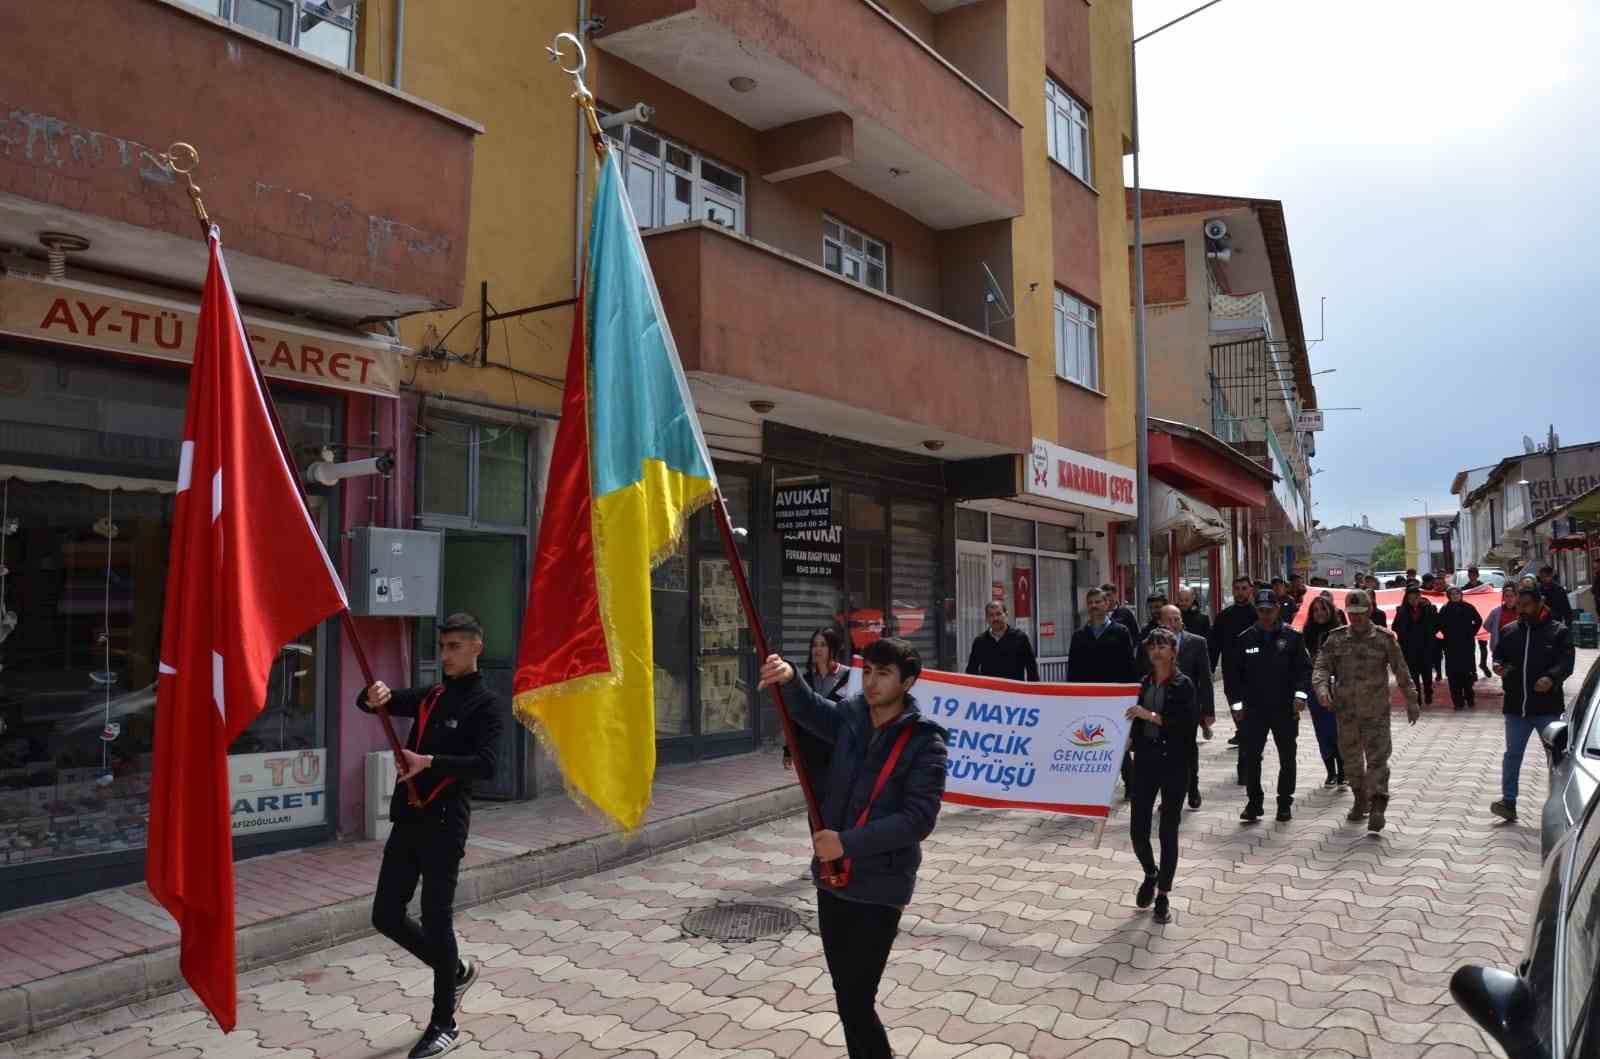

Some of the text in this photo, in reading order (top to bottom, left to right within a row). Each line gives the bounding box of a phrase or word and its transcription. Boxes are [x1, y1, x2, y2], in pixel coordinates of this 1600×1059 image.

[40, 298, 375, 385] AY-TÜ ARET
[1057, 459, 1107, 498] KARAMAN
[776, 488, 829, 506] AVUKAT
[799, 526, 842, 544] AVUKAT
[932, 696, 960, 717] 19
[965, 702, 1041, 727] MAYIS
[944, 728, 1033, 758] ENÇLİK
[943, 755, 1036, 792] RÜYÜŞÜ
[231, 790, 323, 815] ARET
